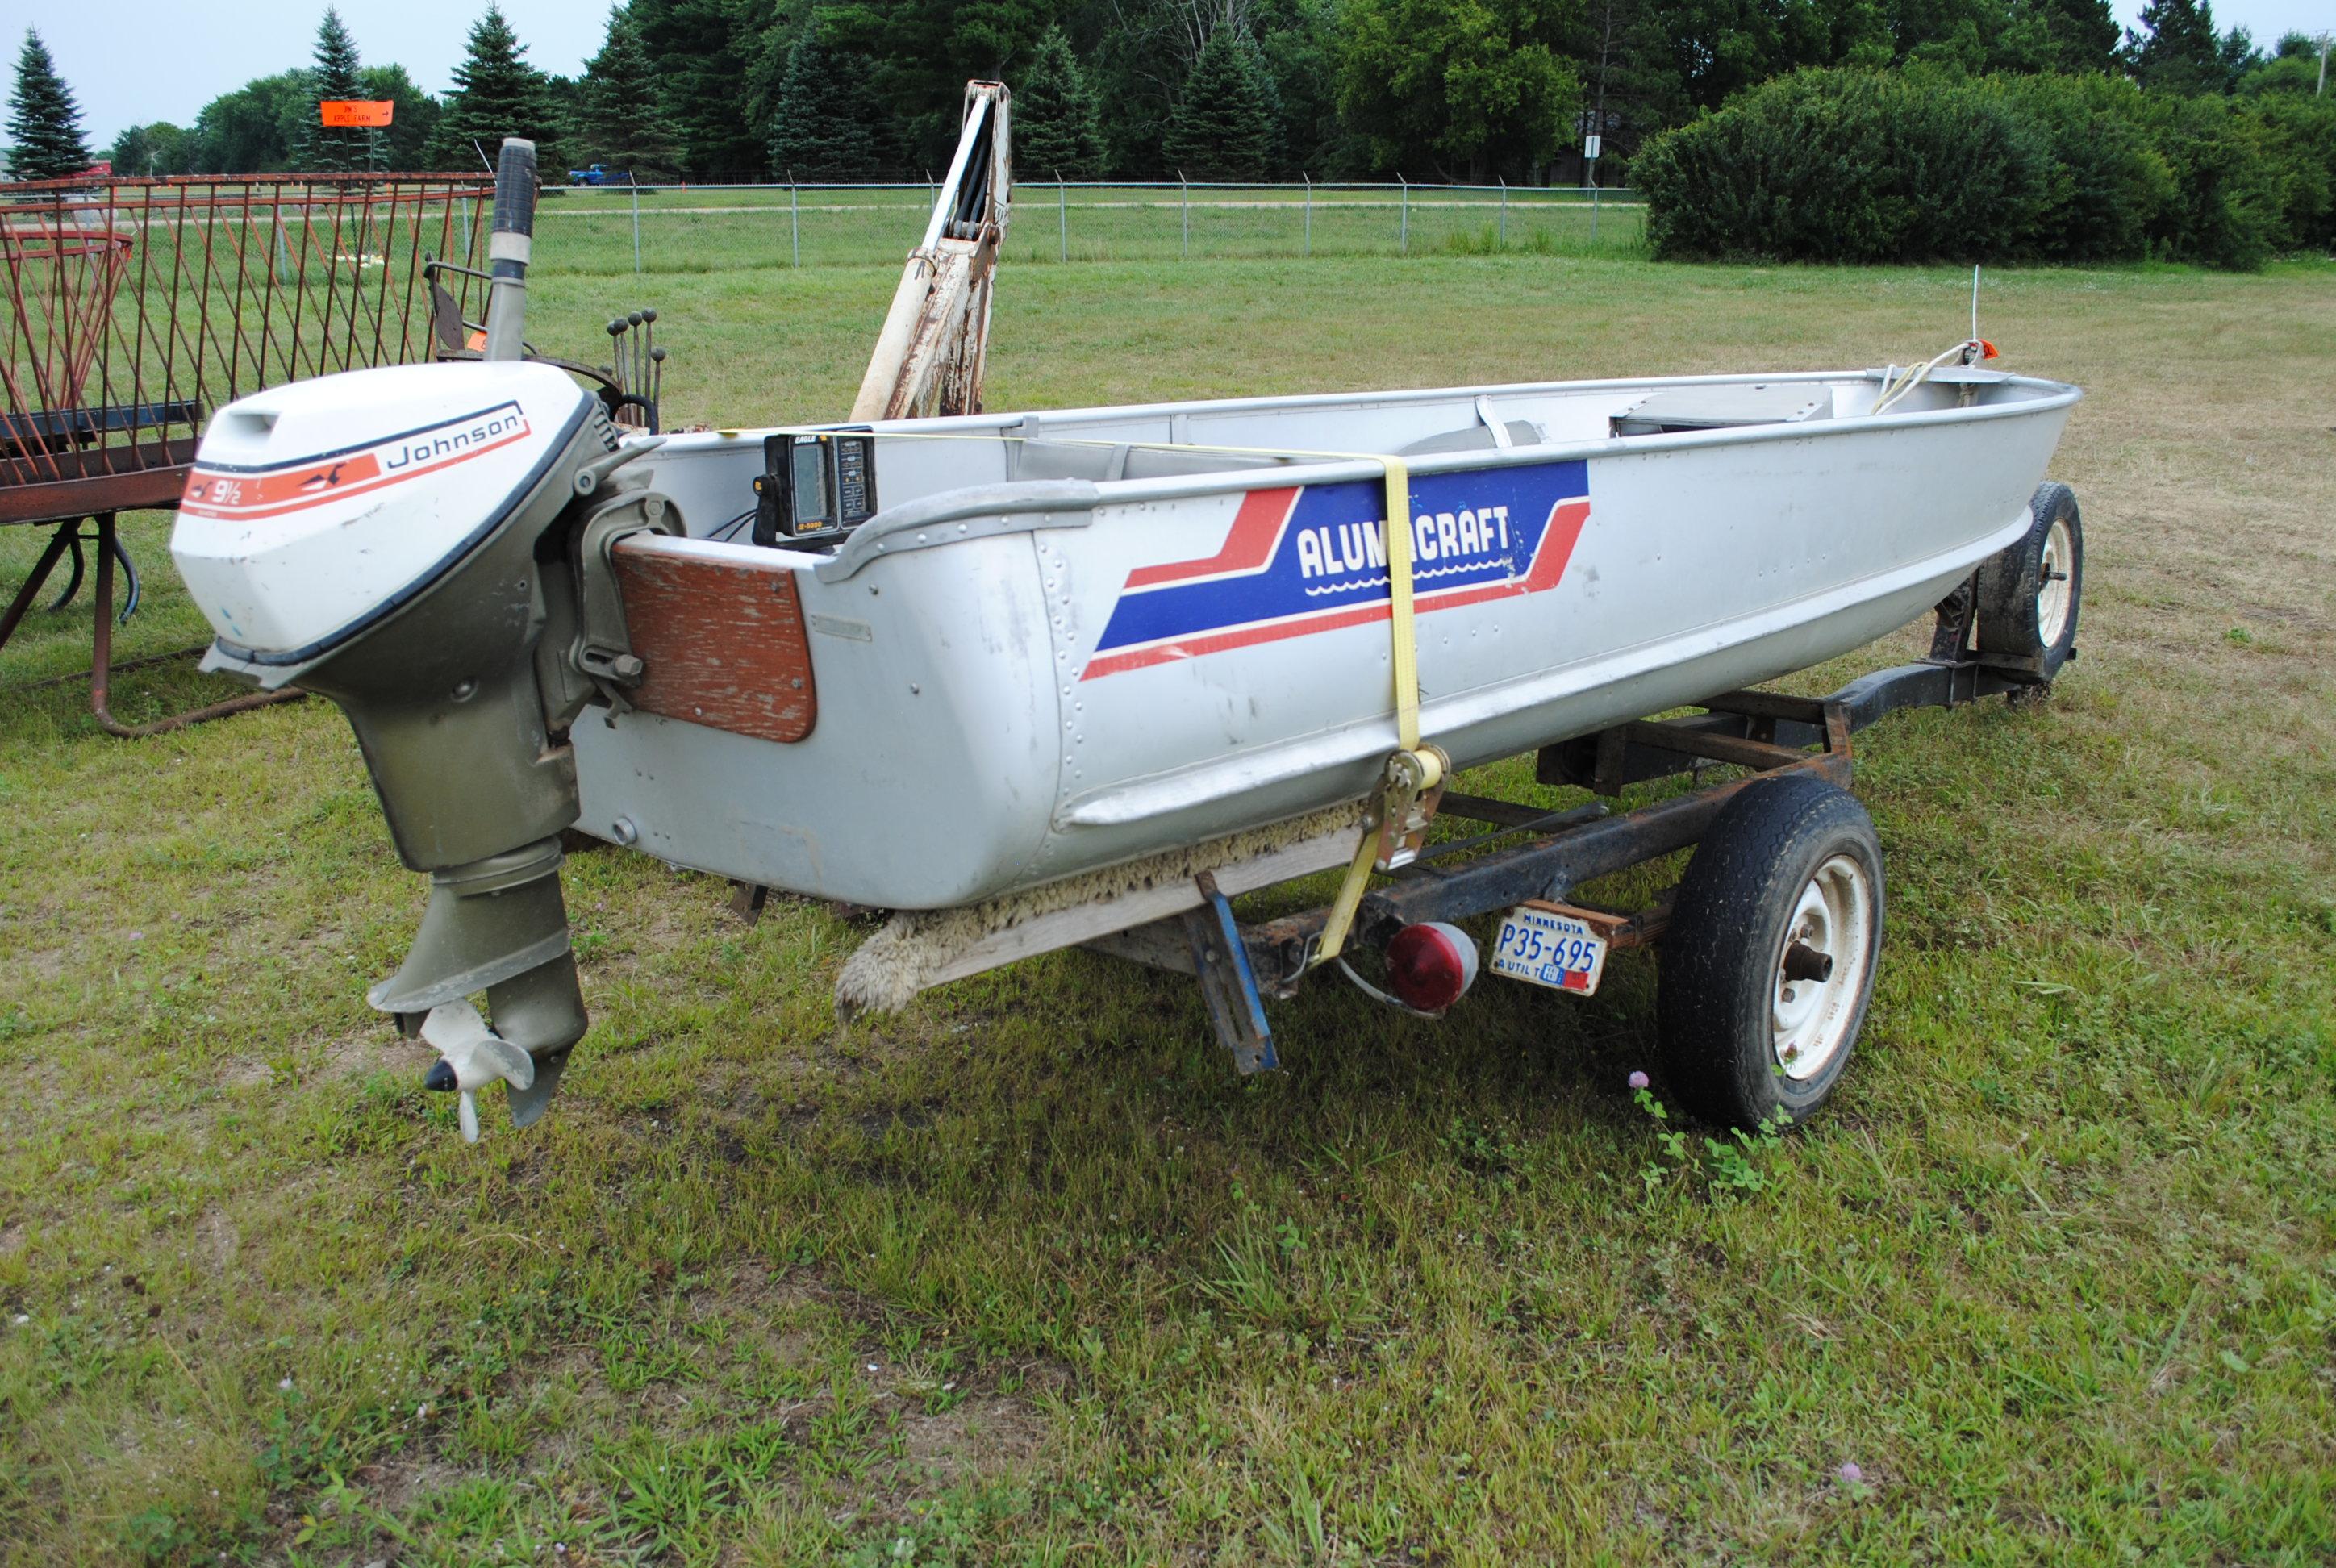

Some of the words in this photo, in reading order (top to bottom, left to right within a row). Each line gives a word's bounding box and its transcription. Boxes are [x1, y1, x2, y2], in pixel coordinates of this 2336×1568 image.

[333, 115, 350, 123] APPLE
[354, 115, 371, 123] FARM
[387, 415, 518, 469] Johnson
[795, 435, 816, 444] EAGLE
[1296, 506, 1508, 578] ALUMCRAFT
[1523, 913, 1584, 936] MINNESOTA
[1498, 923, 1596, 973] P35-695
[1508, 961, 1529, 976] UTIL
